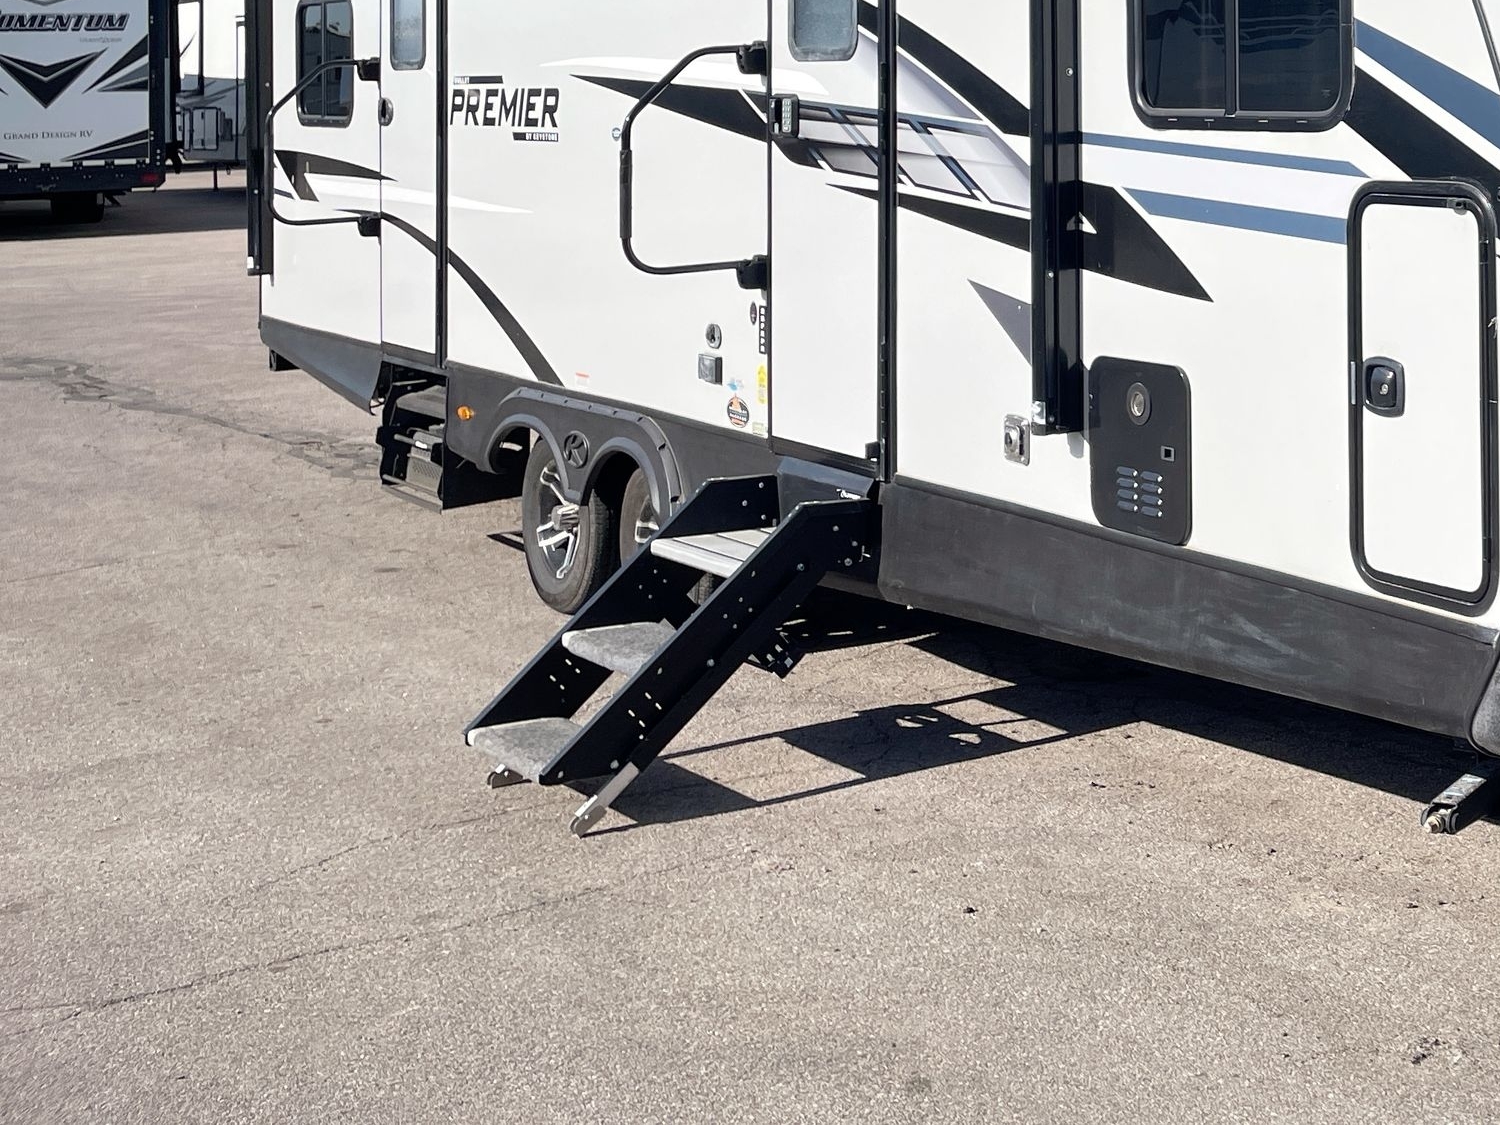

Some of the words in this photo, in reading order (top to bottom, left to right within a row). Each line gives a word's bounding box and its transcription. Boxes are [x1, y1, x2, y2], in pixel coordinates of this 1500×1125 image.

[0, 13, 130, 32] OMENTUM
[449, 88, 560, 128] PREMIER
[79, 130, 94, 138] RV
